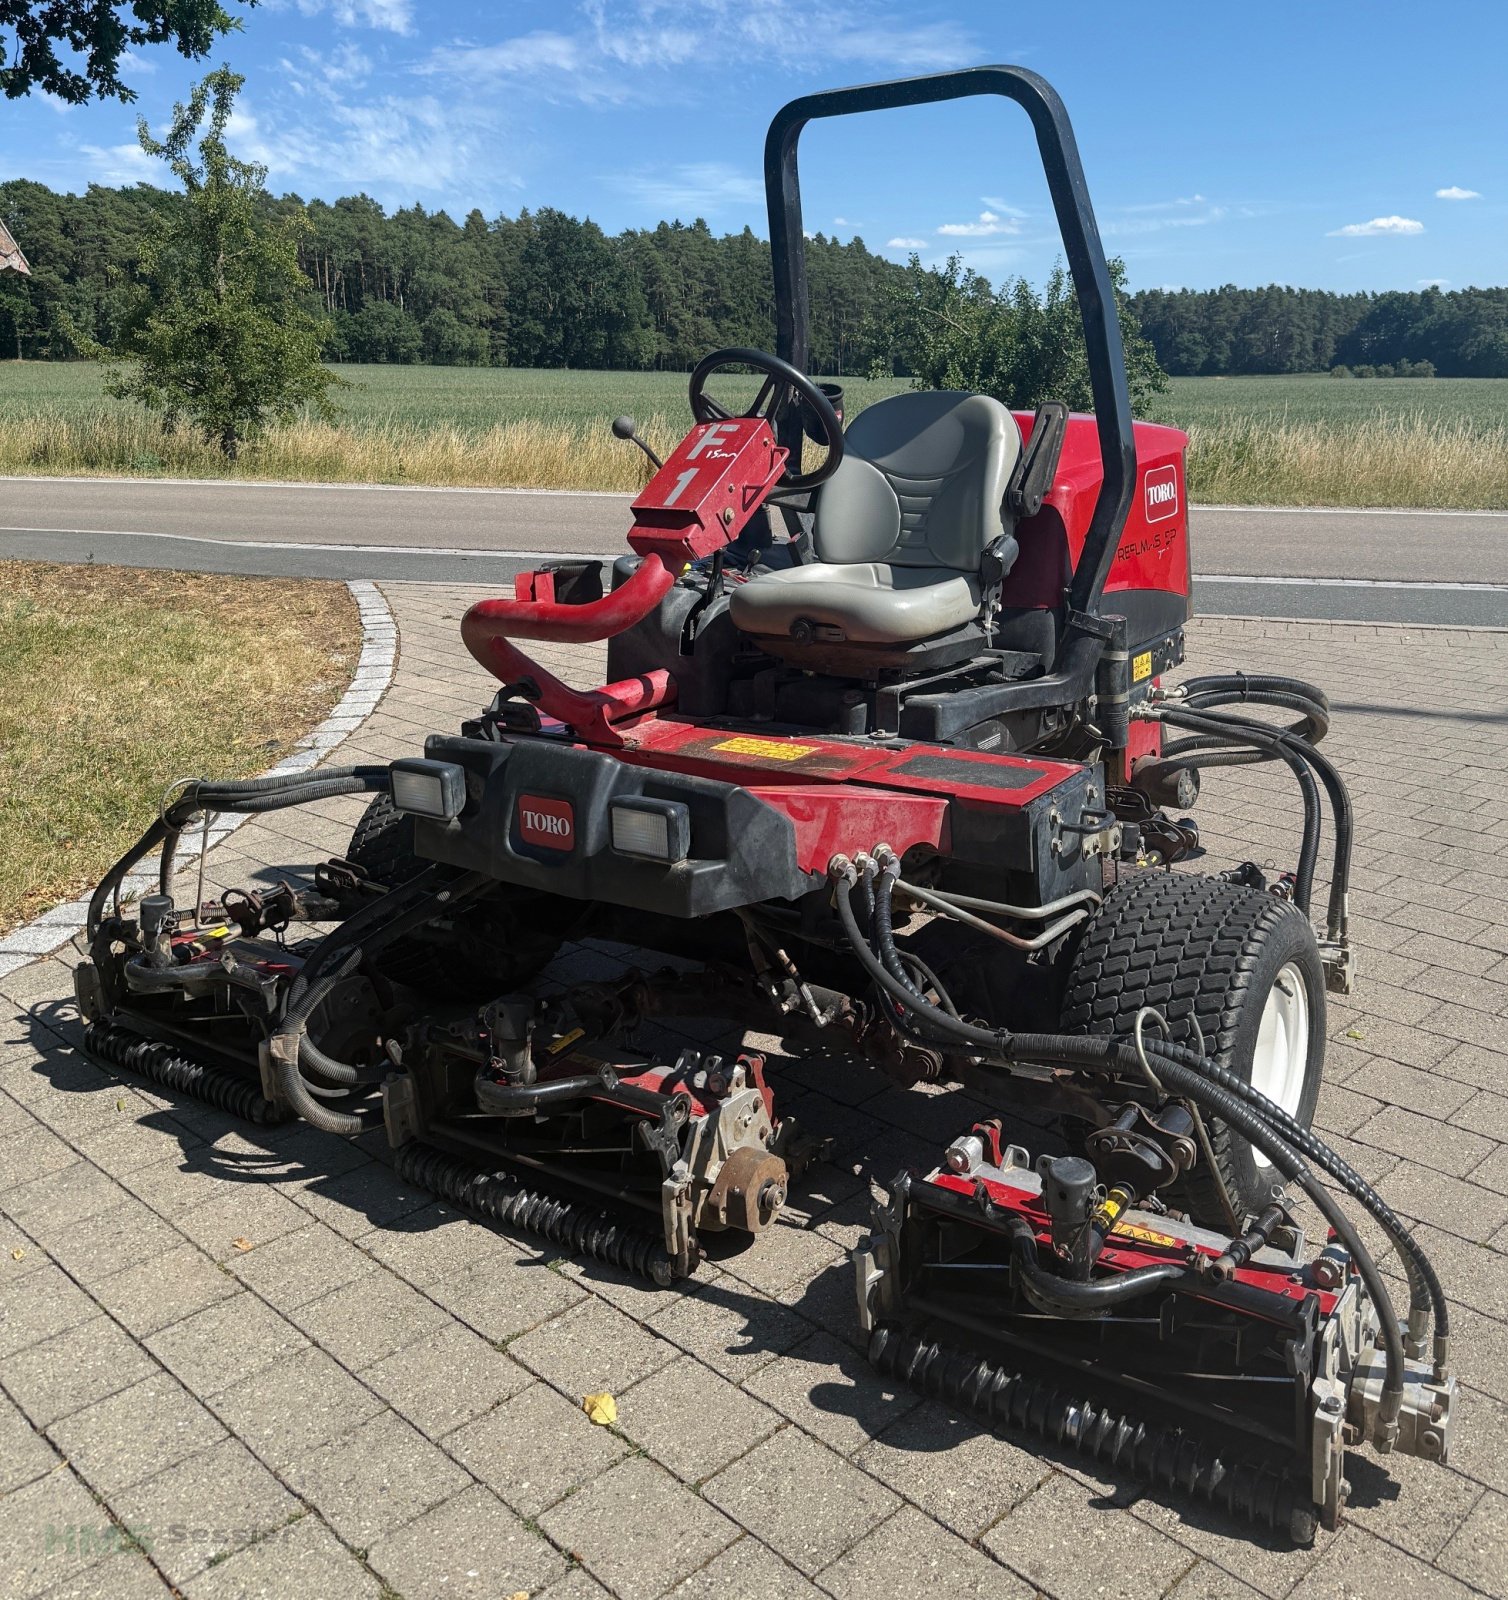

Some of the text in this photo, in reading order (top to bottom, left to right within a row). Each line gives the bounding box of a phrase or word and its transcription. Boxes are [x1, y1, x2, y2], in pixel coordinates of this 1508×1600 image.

[686, 424, 740, 460] F
[663, 468, 700, 506] 1
[523, 810, 570, 836] TORO
